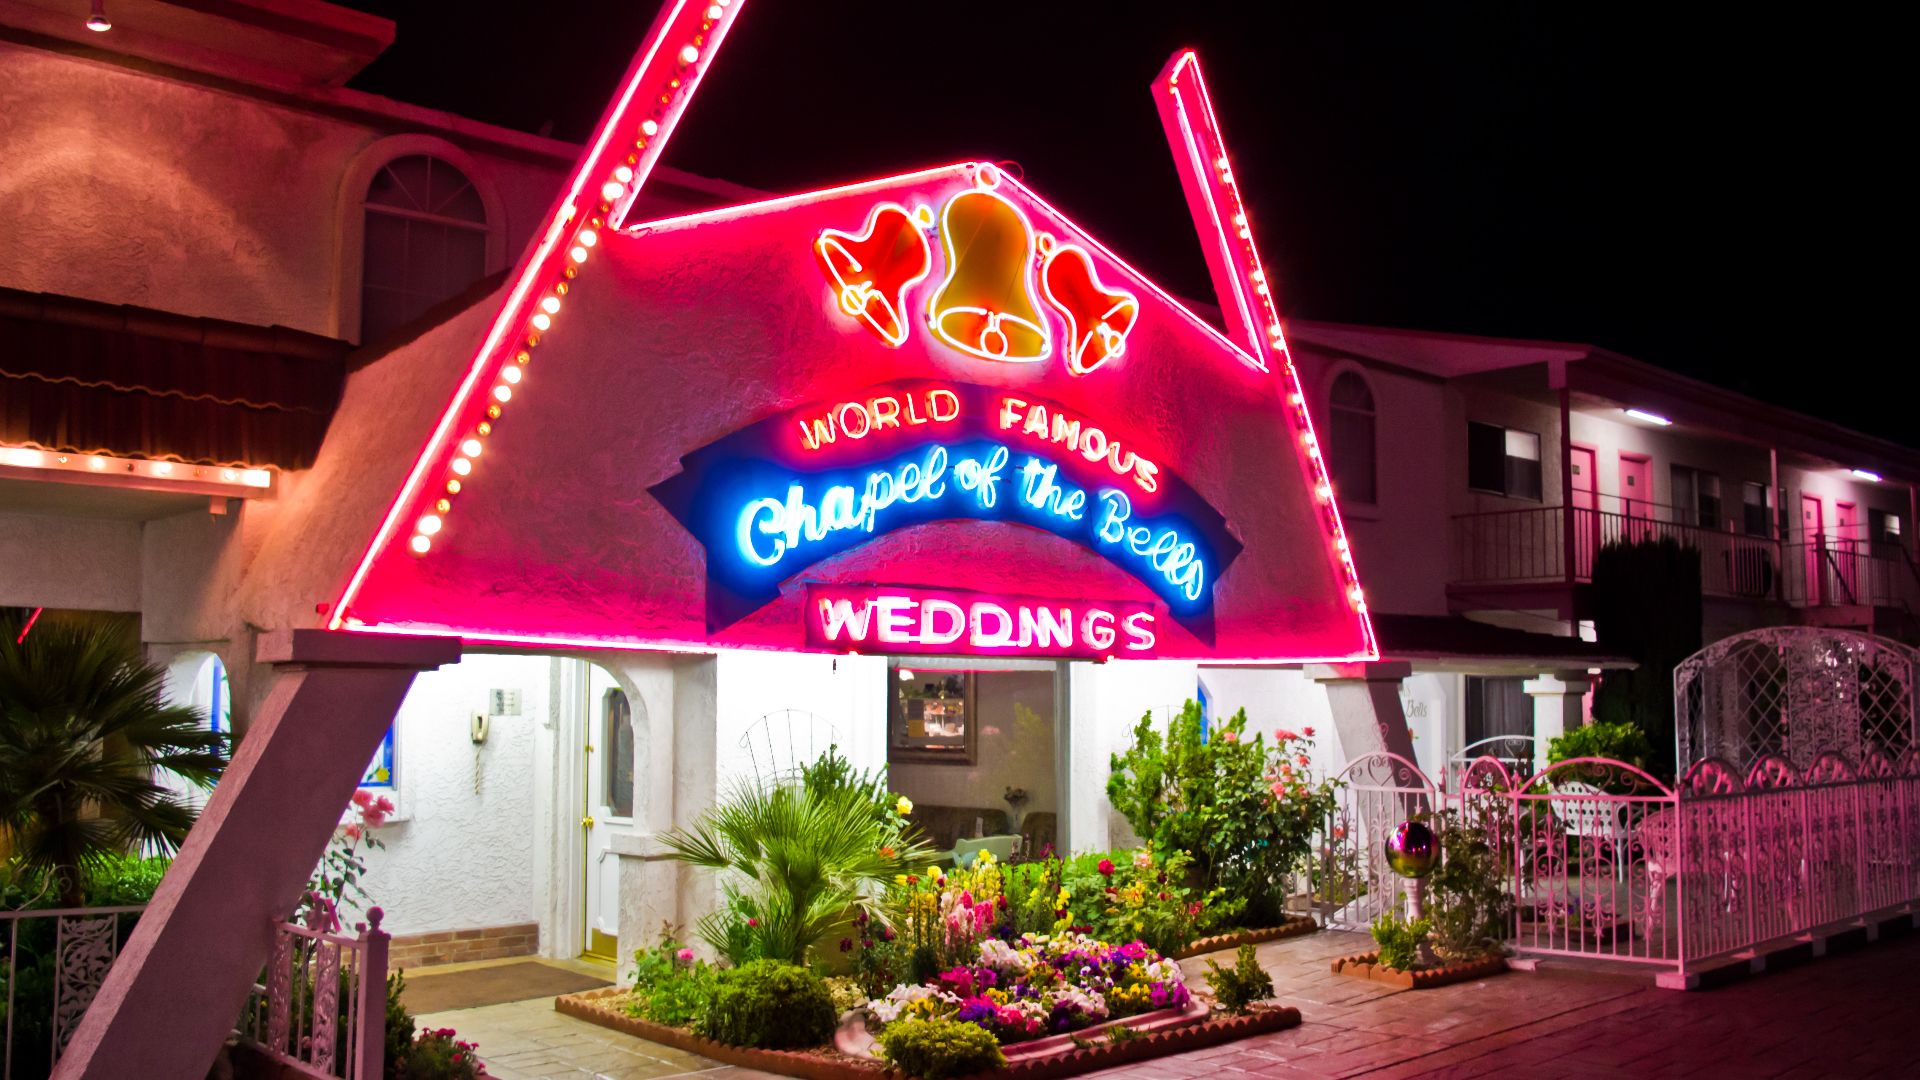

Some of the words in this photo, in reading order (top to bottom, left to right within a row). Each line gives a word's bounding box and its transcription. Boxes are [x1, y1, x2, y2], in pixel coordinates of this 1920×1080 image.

[799, 389, 960, 451] WORLD
[1000, 397, 1159, 494] FAMOUS
[741, 445, 948, 567] Chapel
[954, 446, 1009, 508] of
[1022, 457, 1087, 520] the
[1098, 486, 1205, 602] Bells
[817, 595, 1156, 651] WEDDINGS
